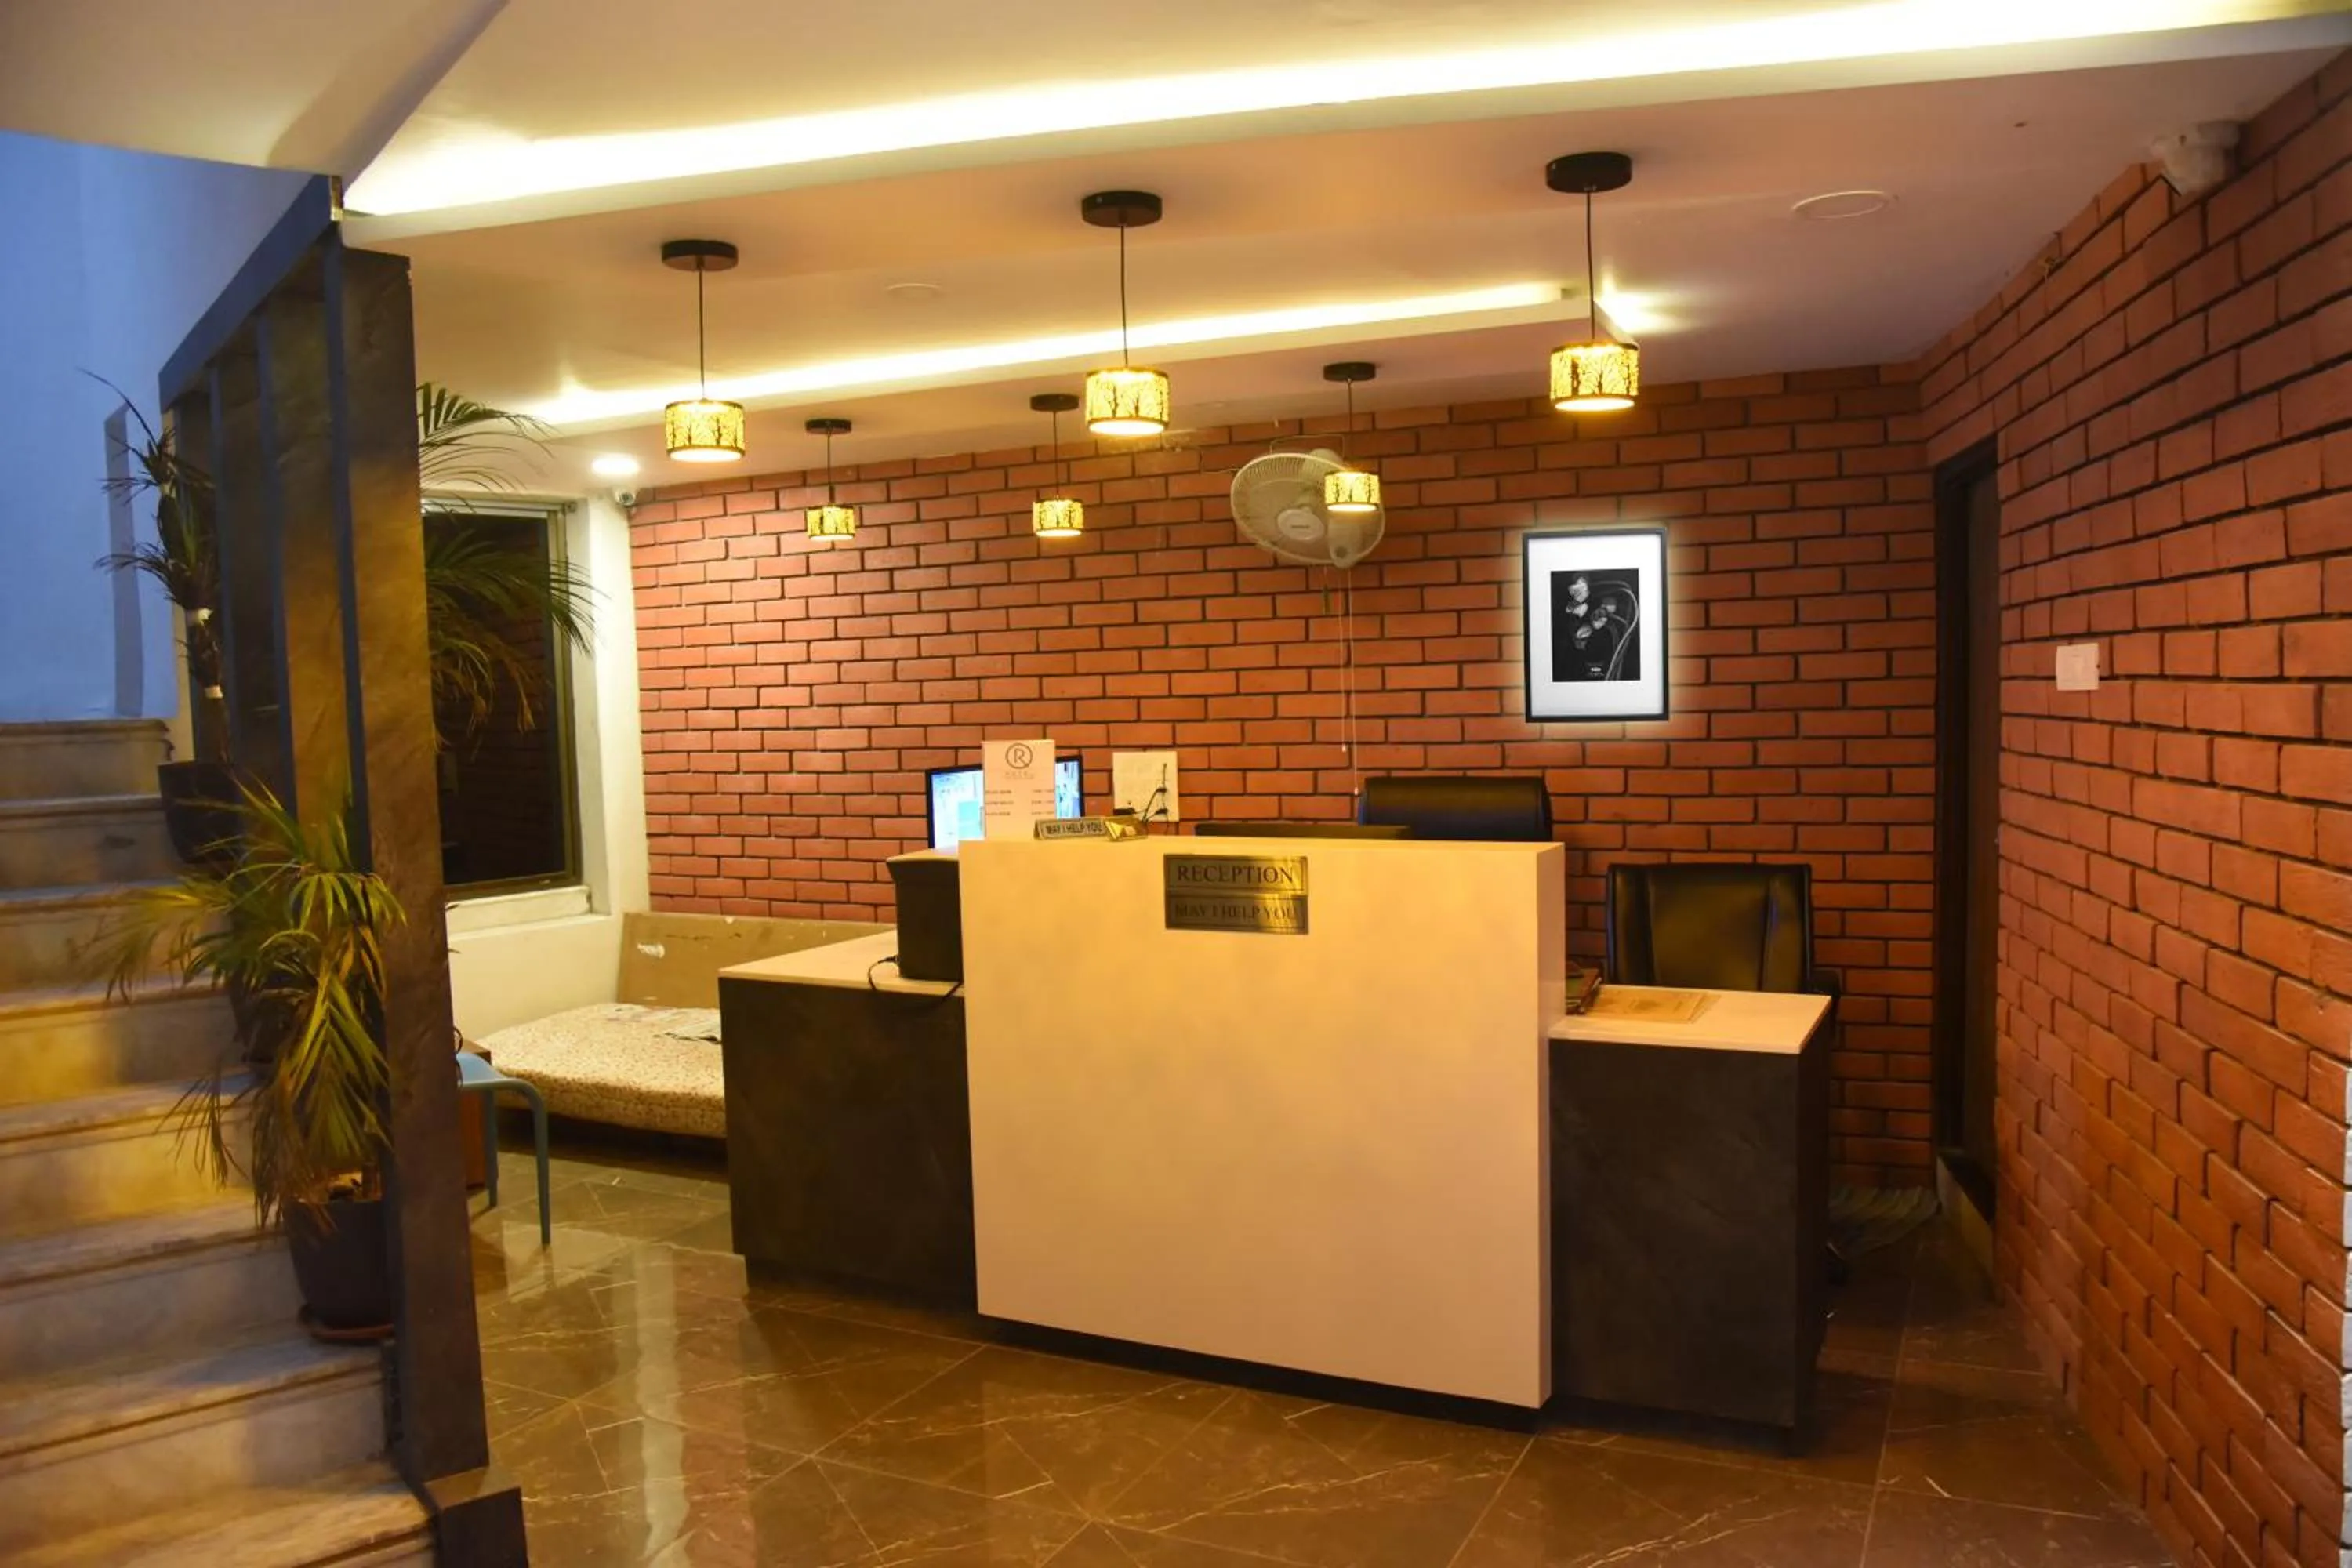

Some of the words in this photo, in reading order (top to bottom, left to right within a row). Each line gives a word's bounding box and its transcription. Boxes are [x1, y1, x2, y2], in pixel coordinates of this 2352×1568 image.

[1046, 824, 1060, 834] MAY
[1067, 822, 1084, 833] HELP
[1087, 822, 1102, 832] YOU
[1178, 864, 1293, 884] RECEPTION
[1175, 904, 1206, 916] MAY
[1211, 904, 1218, 916] I
[1222, 905, 1260, 919] HELP
[1263, 906, 1297, 920] YOU
